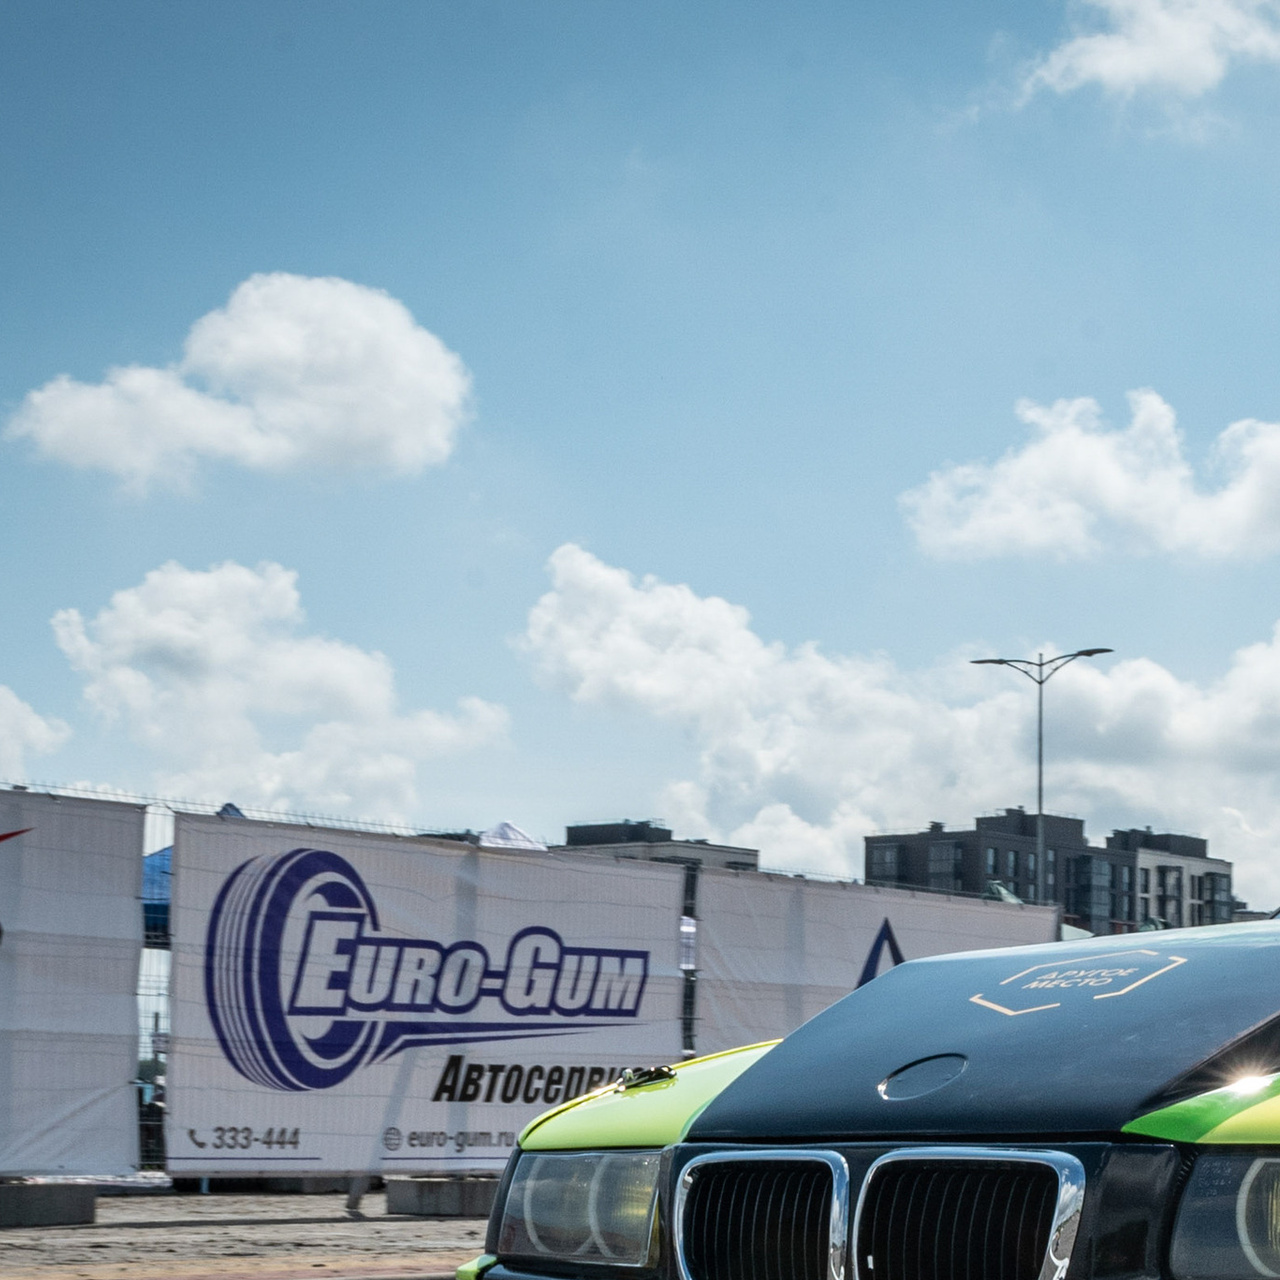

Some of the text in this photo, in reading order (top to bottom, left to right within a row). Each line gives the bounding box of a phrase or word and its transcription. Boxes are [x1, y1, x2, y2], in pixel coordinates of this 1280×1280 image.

[1021, 977, 1113, 990] МЕСТО
[212, 1126, 300, 1150] 333-444
[406, 1129, 517, 1152] euro-gum.ru
